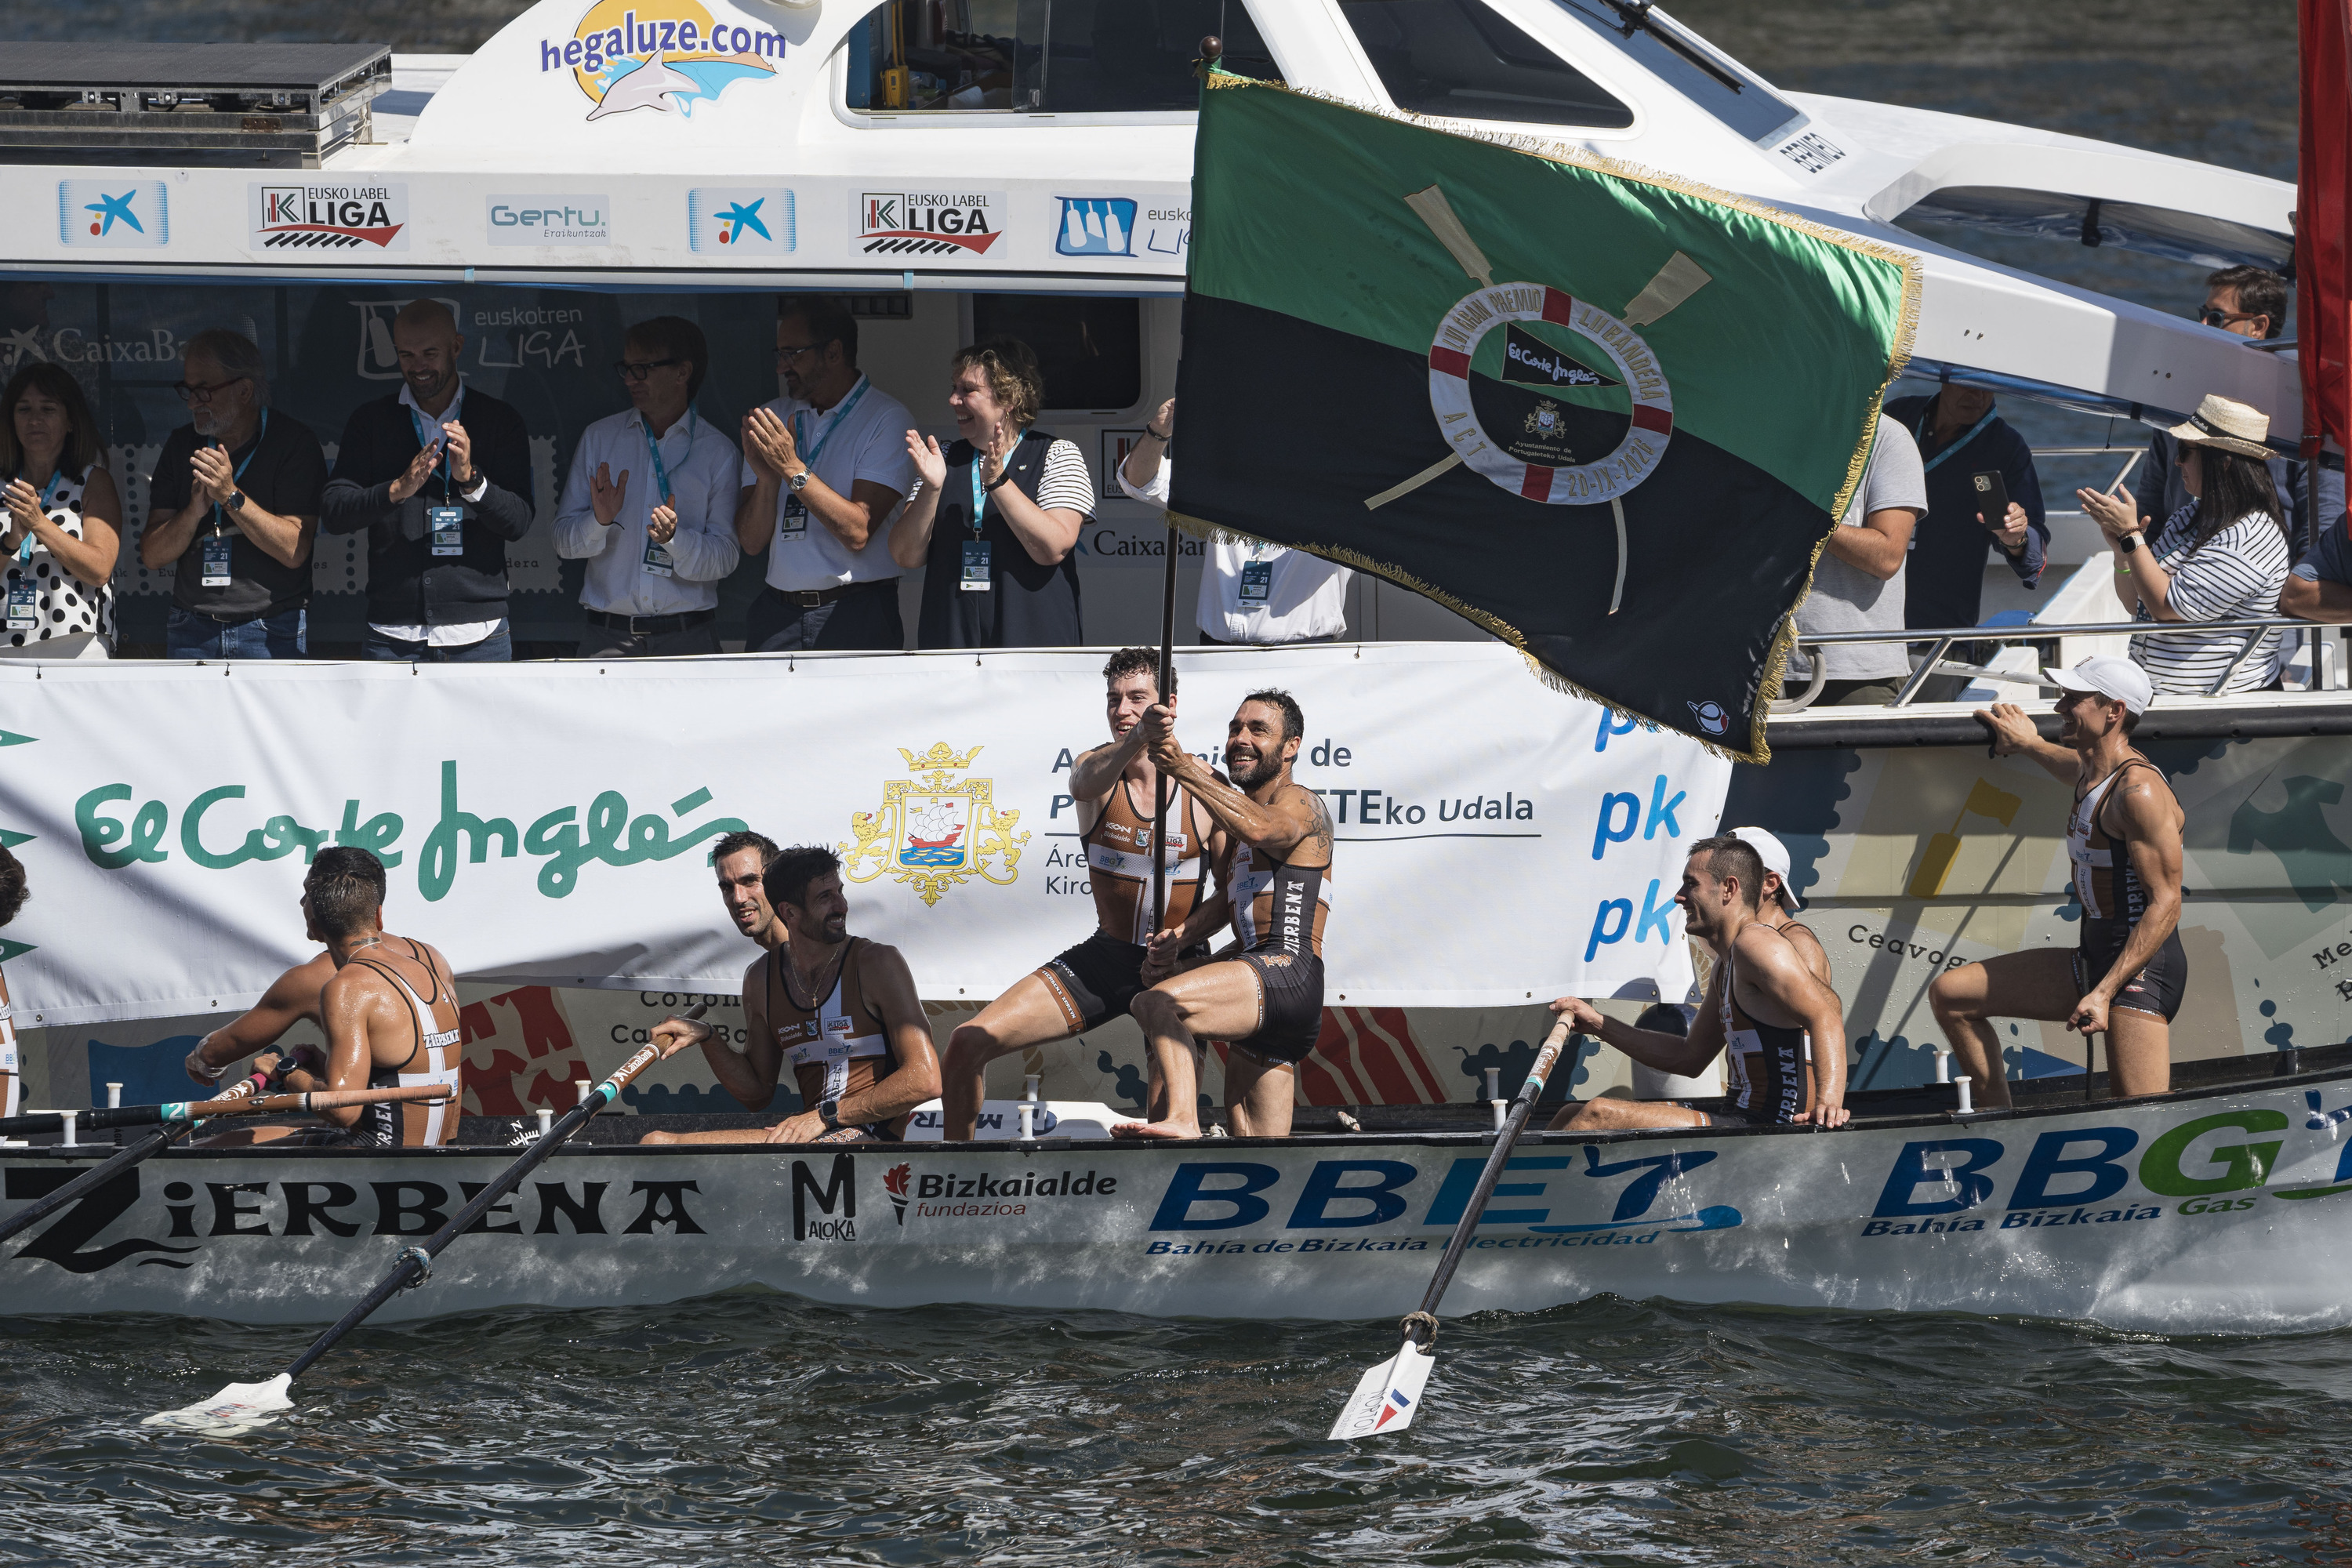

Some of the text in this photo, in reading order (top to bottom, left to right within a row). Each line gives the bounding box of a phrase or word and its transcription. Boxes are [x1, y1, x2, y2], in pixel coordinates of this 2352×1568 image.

[540, 9, 786, 73] hegaluze.com
[1779, 132, 1846, 173] BERMEO
[308, 188, 391, 200] EUSKO LABEL
[908, 194, 989, 207] EUSKO LABEL
[310, 202, 391, 227] LIGA
[909, 209, 989, 234] LIGA
[543, 229, 608, 239] Eraikuntzak
[475, 307, 583, 326] euskotren
[1452, 299, 1493, 333] GRAN
[1490, 288, 1541, 314] PREMIO
[479, 328, 586, 368] LIGA
[1508, 342, 1599, 385] El Corte Inglés
[1602, 325, 1665, 401] BANDERA
[1508, 445, 1576, 463] Portugaleteko Udala
[1515, 440, 1561, 452] Ayuntamiento
[1107, 485, 1123, 494] EUS
[1310, 738, 1352, 767] de
[1439, 790, 1534, 823] Udala
[74, 782, 169, 869] El
[1045, 844, 1087, 868] Áre
[169, 1102, 184, 1120] 2
[917, 1170, 1118, 1201] Bizkaialde
[916, 1200, 1027, 1218] fundazioa
[1860, 1195, 2257, 1238] Bahía Bizkaia Gas
[1145, 1240, 1249, 1254] Bahía
[1252, 1240, 1294, 1254] de
[1298, 1237, 1428, 1254] Bizkaia
